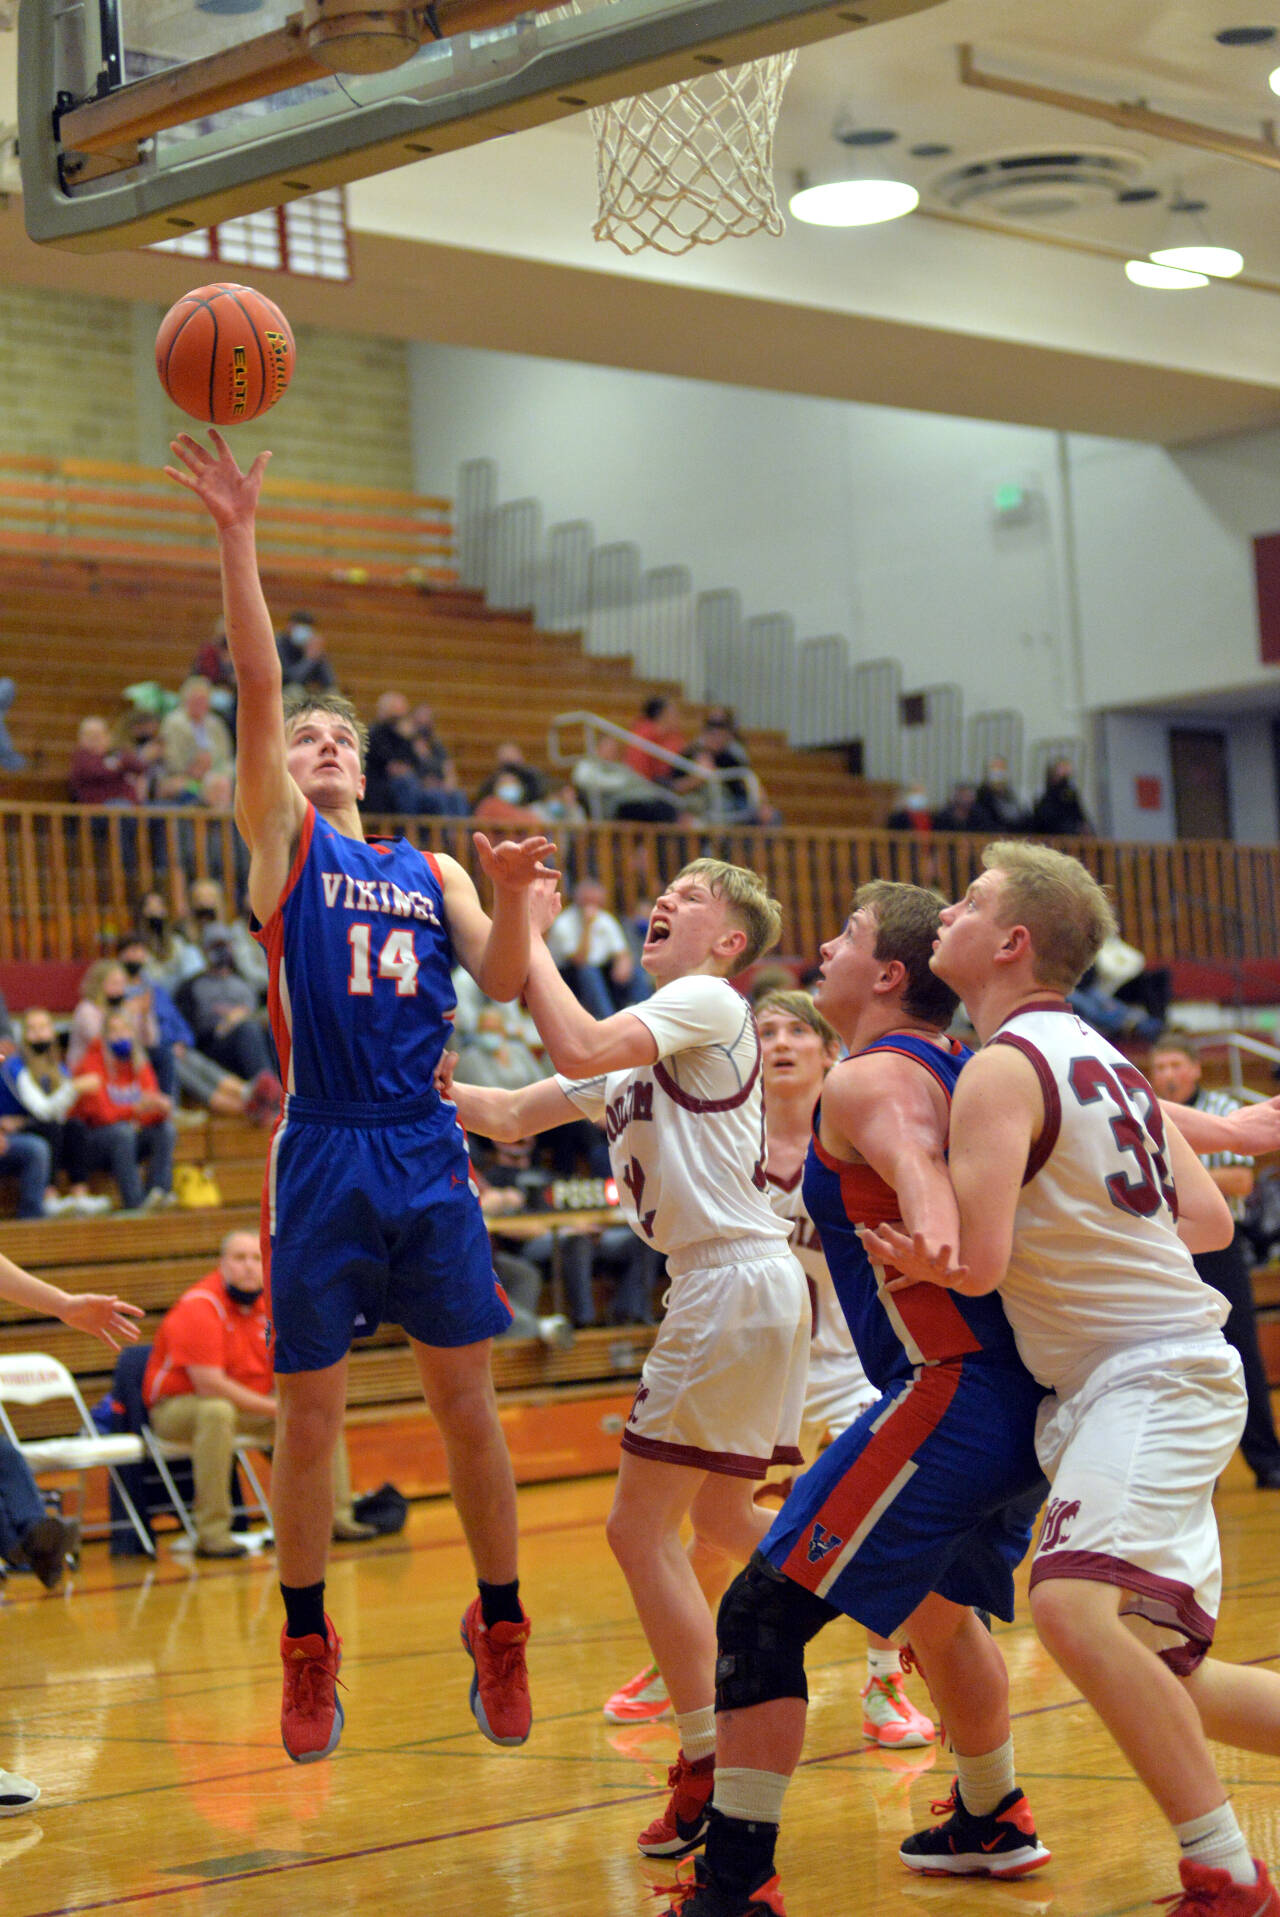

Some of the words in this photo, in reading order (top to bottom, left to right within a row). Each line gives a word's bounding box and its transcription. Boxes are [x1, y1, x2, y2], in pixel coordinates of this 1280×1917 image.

[232, 345, 247, 415] ELITE
[347, 922, 421, 996] 14
[1068, 1055, 1180, 1225] 32
[552, 1177, 607, 1210] POSS
